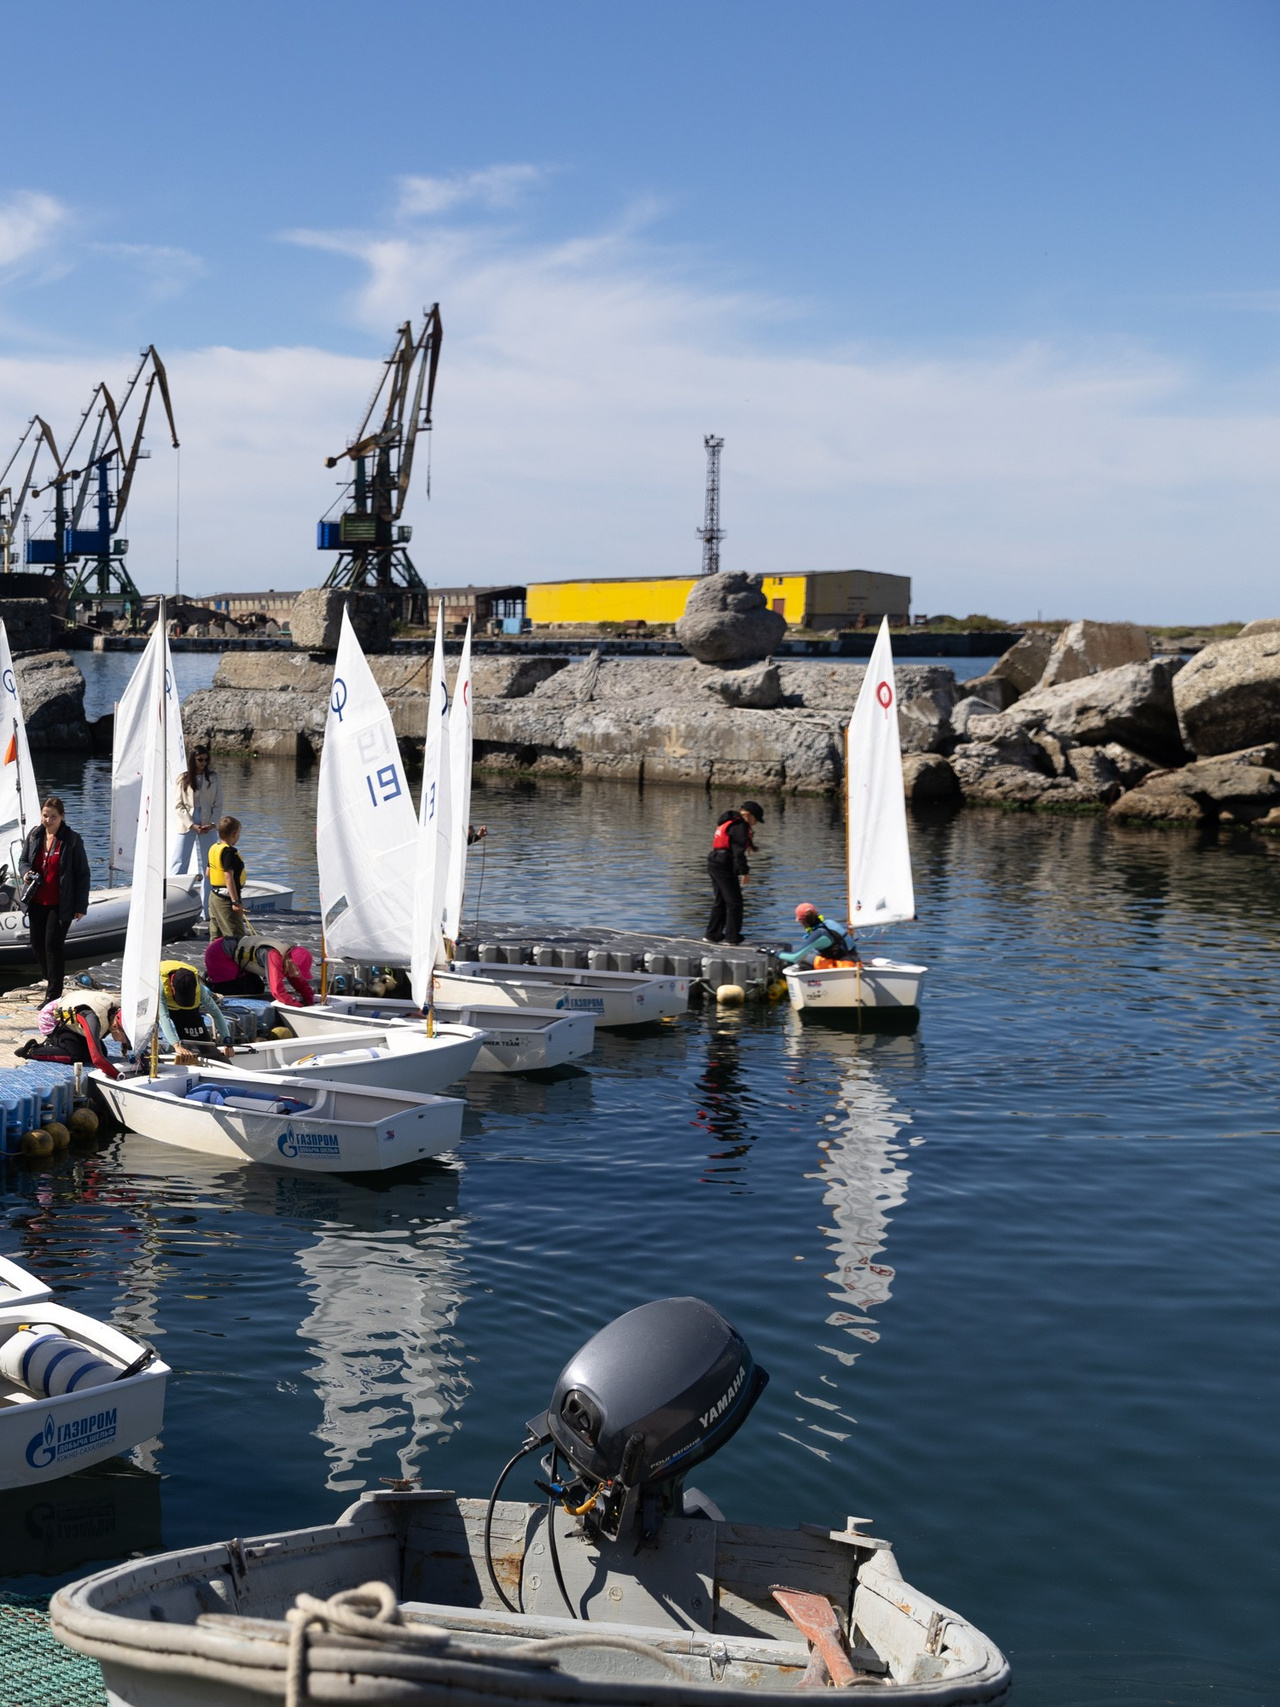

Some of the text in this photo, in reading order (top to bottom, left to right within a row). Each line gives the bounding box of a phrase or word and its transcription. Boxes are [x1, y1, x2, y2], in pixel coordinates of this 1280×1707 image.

[366, 763, 402, 807] 19
[296, 1133, 339, 1146] ГАЗПРОМ
[699, 1366, 746, 1428] YAMAHA
[57, 1408, 117, 1443] ГАЗПРОМ
[56, 1438, 117, 1462] ЮЖНО-САХАЛИНСК
[58, 1428, 115, 1454] ДОБЫЧА ШЕЛЬФ
